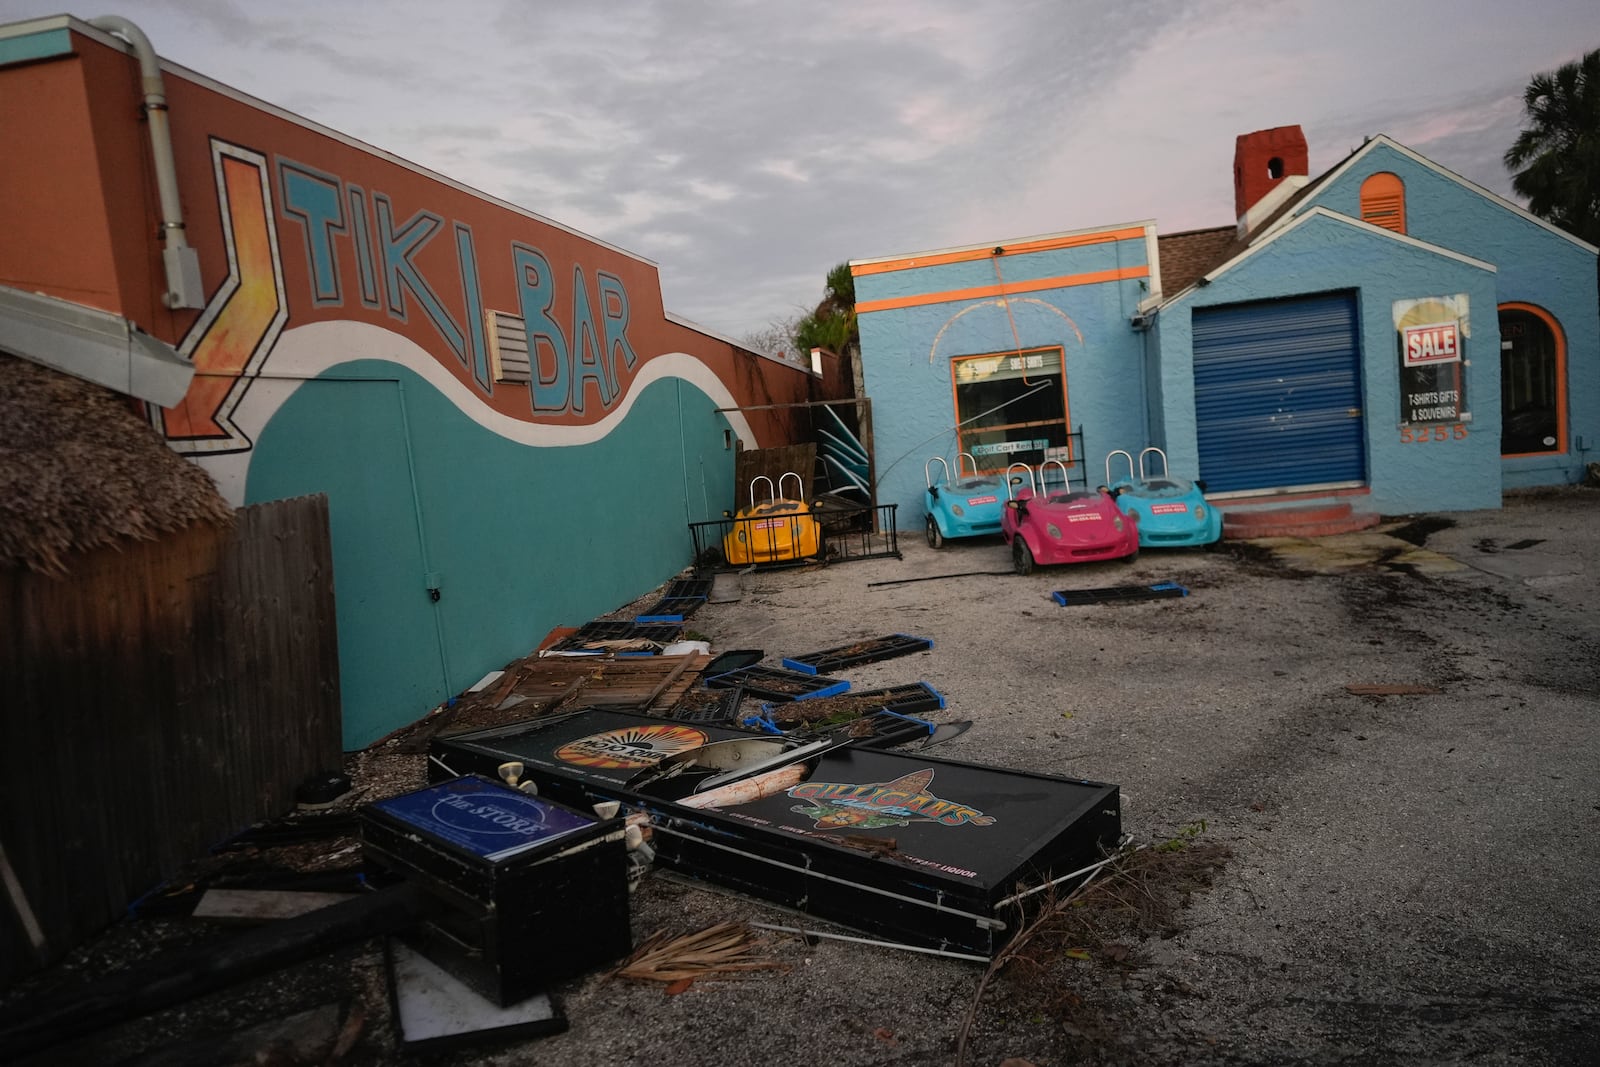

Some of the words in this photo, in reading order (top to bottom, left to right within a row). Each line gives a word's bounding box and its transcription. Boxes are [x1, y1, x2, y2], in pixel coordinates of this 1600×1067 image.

[276, 155, 492, 396] TIKI
[511, 240, 636, 416] BAR
[1410, 330, 1454, 358] SALE
[1408, 391, 1438, 406] T-SHIRTS
[1439, 390, 1459, 403] GIFTS
[1411, 409, 1417, 421] &
[1418, 406, 1457, 420] SOUVENIRS
[1400, 423, 1469, 444] 5255
[996, 442, 1014, 452] Cart
[1016, 440, 1044, 450] Renals
[792, 783, 977, 825] GILLIGAN'S
[470, 806, 549, 834] STORE
[941, 865, 977, 878] LIQUOR
